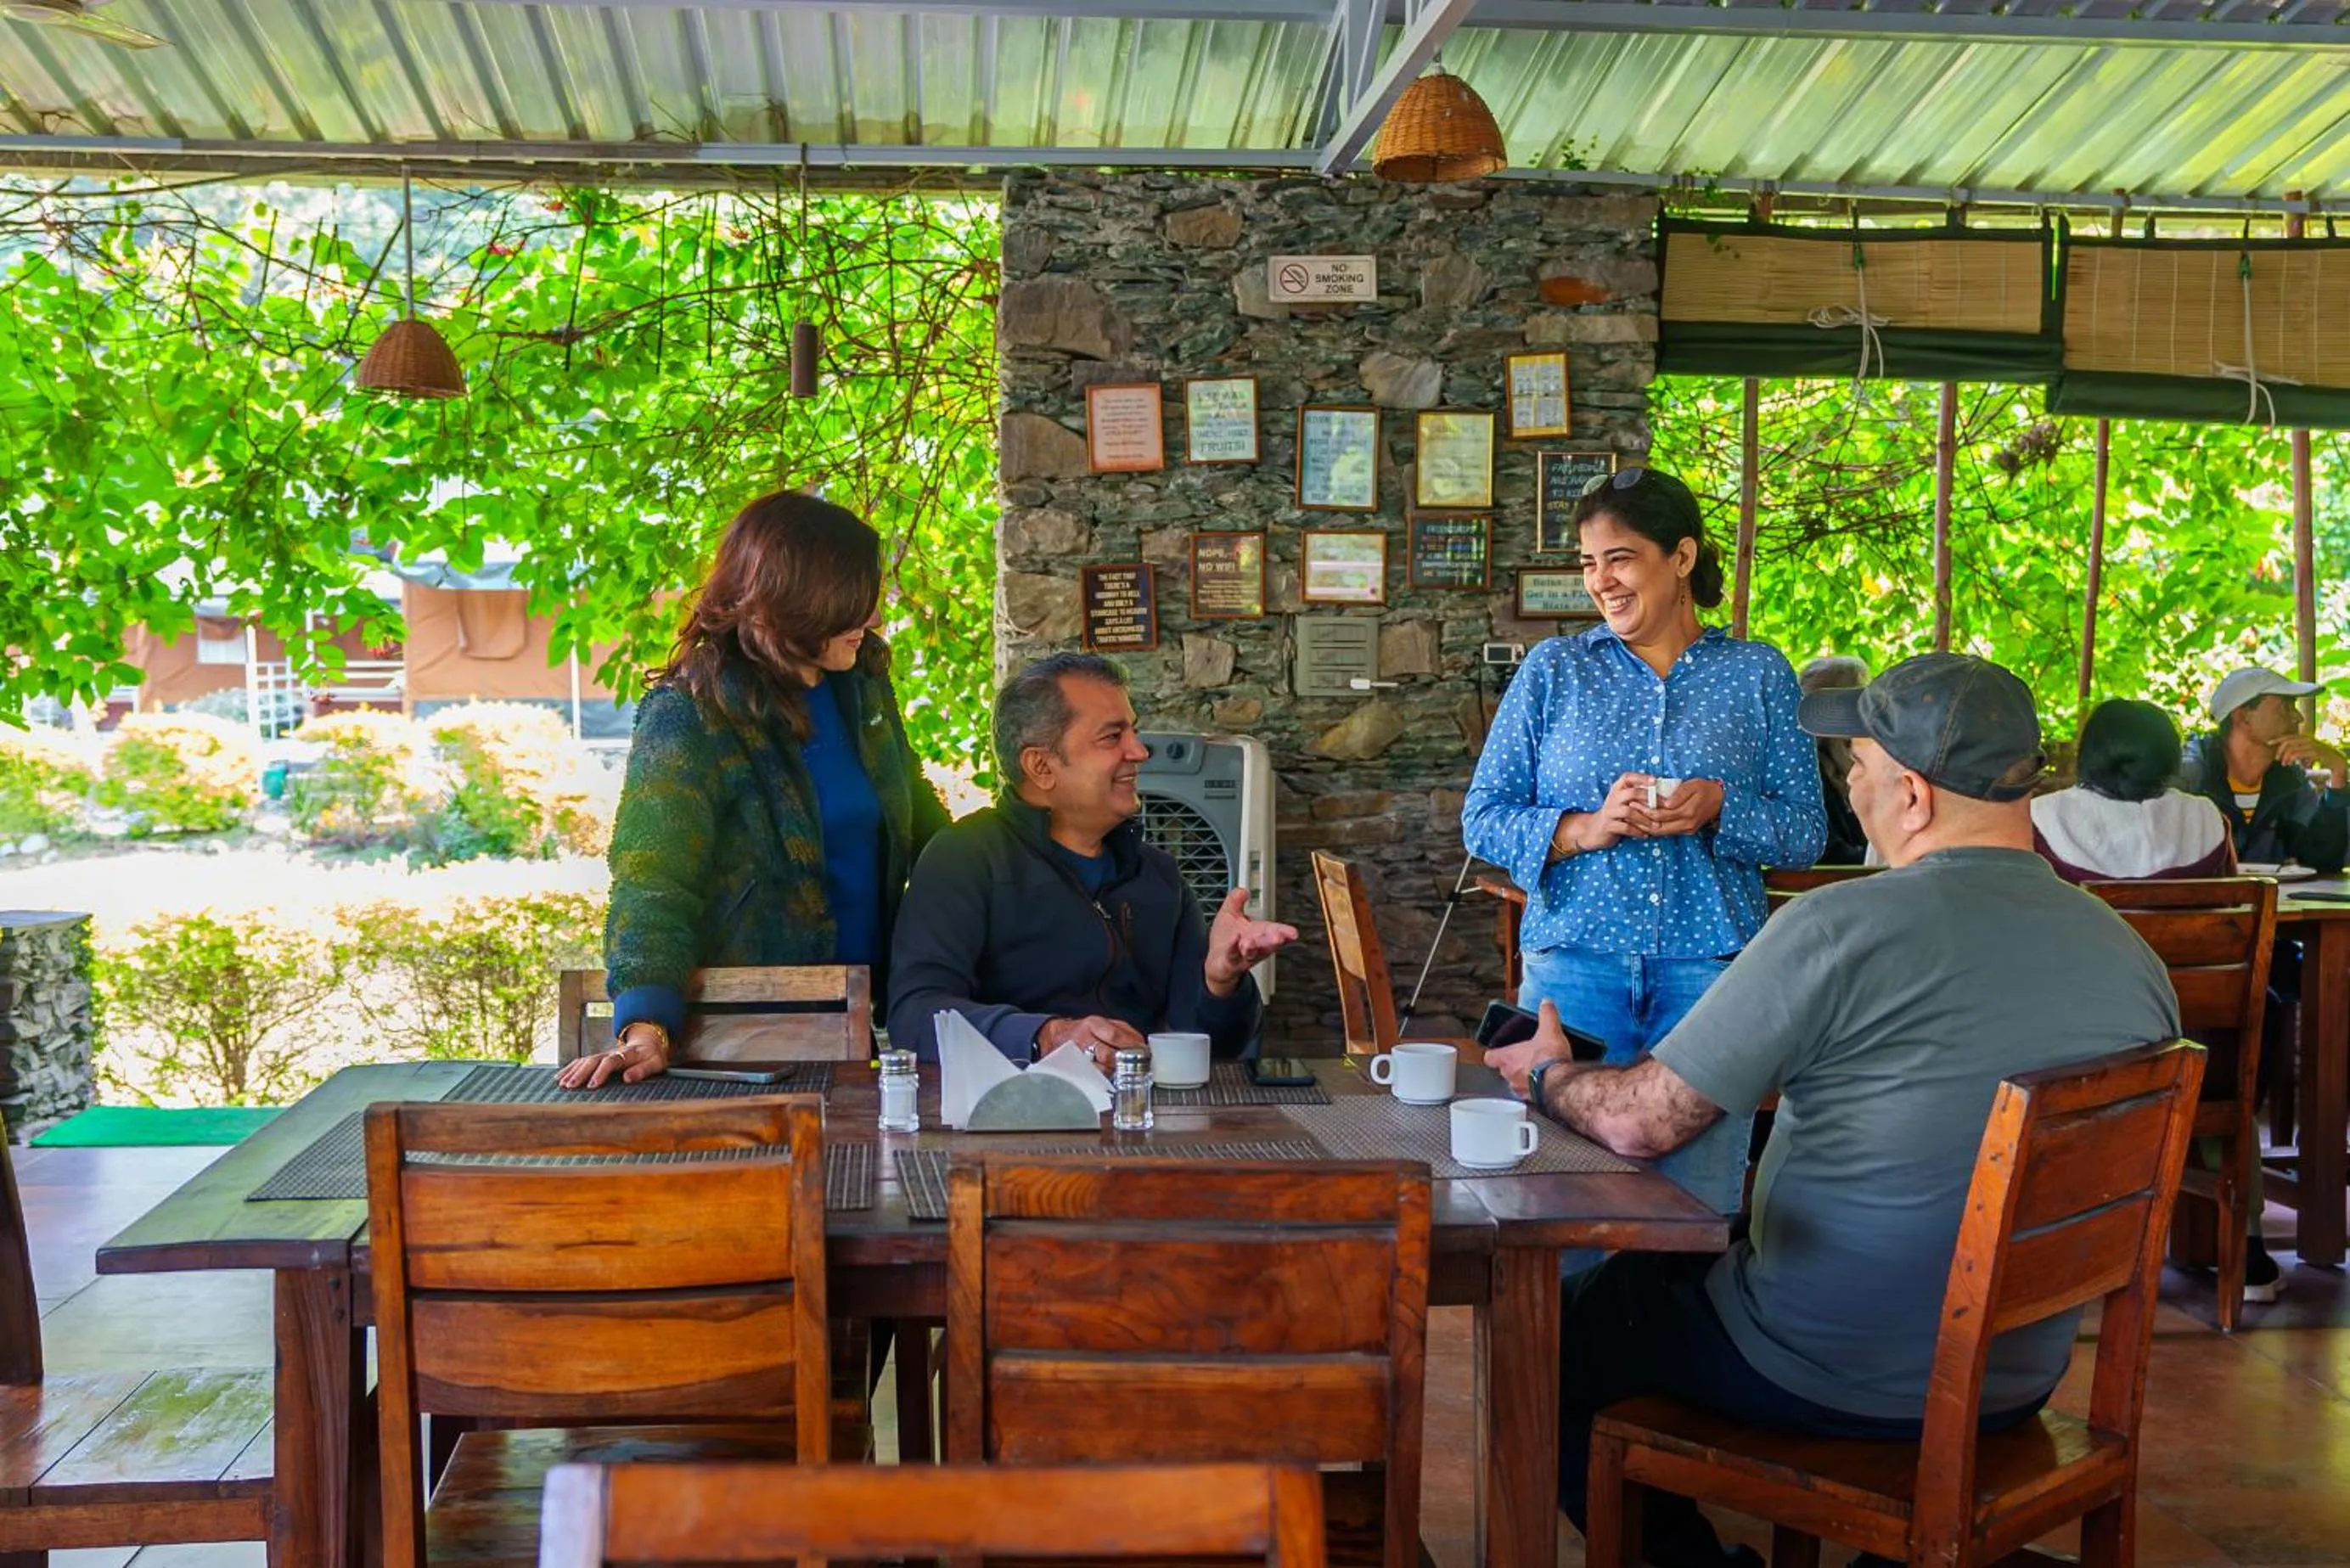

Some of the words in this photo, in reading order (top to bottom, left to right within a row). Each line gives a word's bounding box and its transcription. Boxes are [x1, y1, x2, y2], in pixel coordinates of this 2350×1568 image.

[1331, 264, 1346, 273] NO
[1315, 273, 1364, 283] SMOKING
[1325, 284, 1355, 294] ZONE
[1198, 562, 1212, 572] NO
